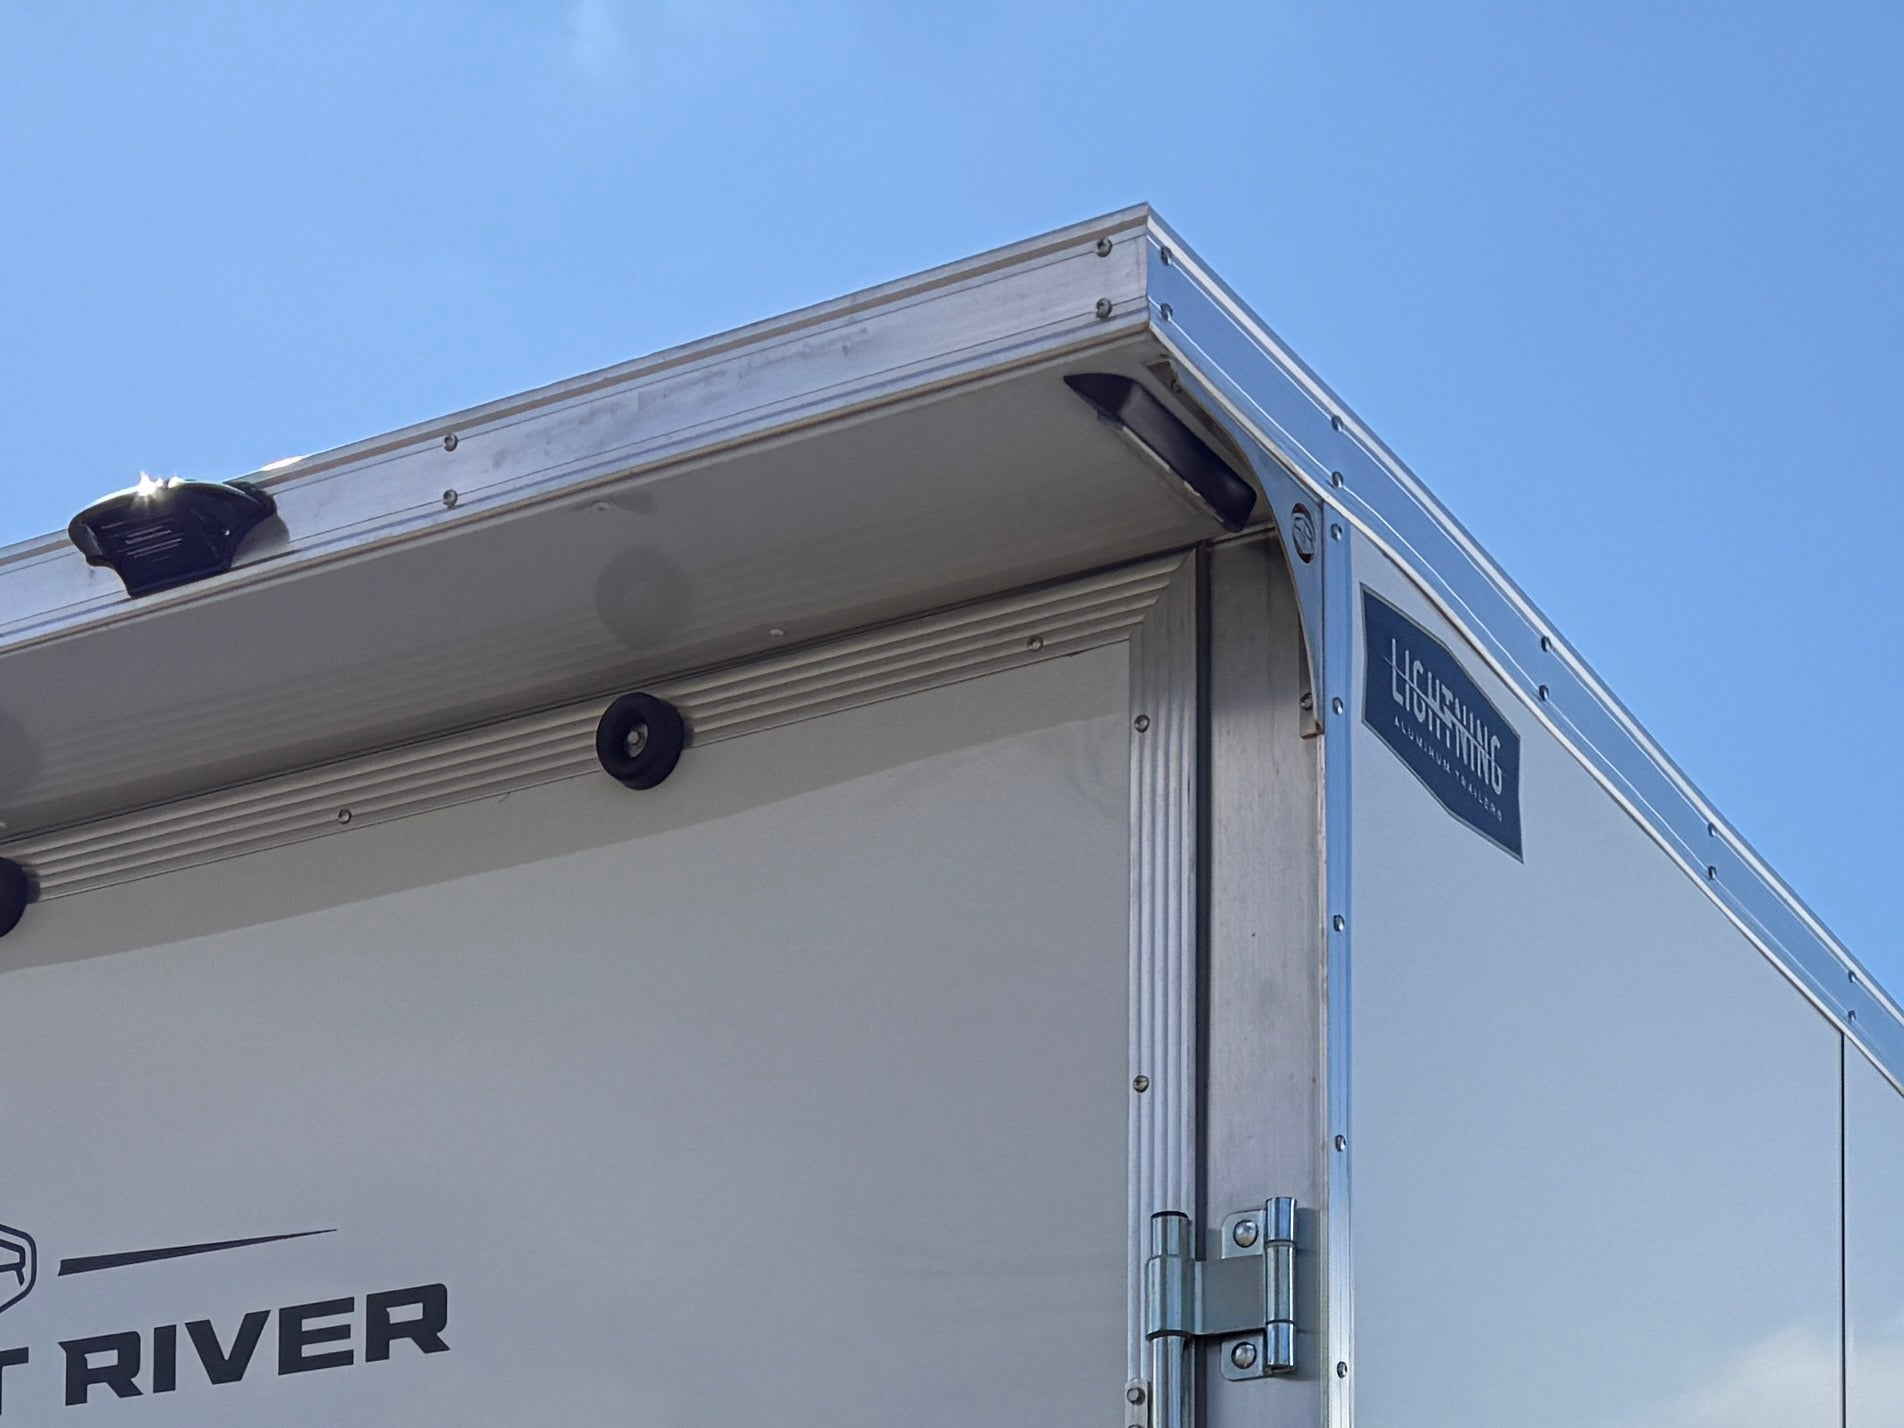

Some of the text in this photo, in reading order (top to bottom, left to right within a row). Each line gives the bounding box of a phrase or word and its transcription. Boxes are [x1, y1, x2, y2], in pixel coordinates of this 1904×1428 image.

[1391, 637, 1503, 795] LIGHTNING
[1394, 716, 1451, 774] ALUMINUM
[58, 1282, 452, 1407] RIVER
